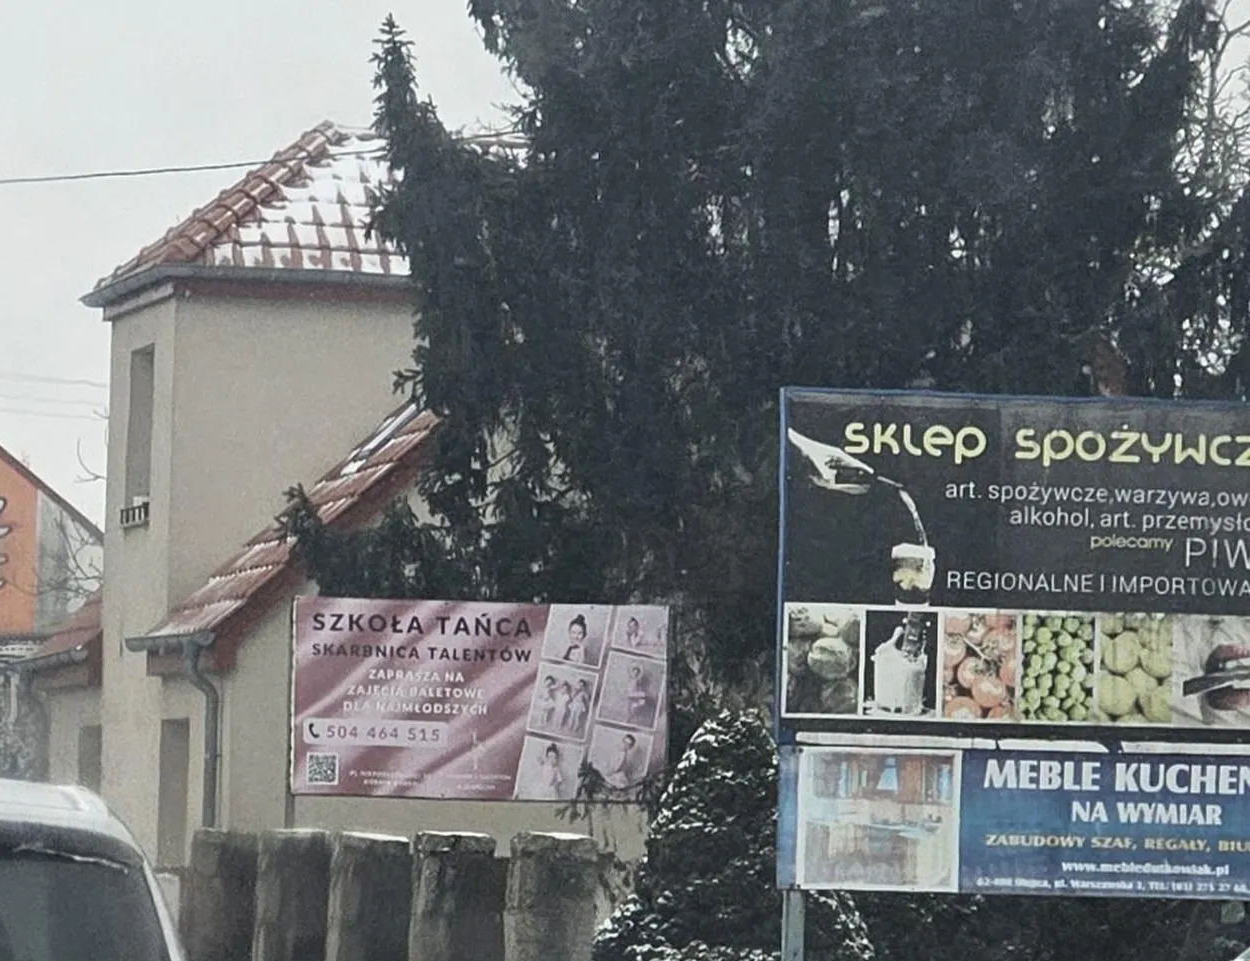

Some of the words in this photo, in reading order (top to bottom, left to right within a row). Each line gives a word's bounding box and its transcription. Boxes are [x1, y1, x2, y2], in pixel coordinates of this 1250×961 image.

[945, 482, 982, 499] art.
[1009, 506, 1095, 529] alkohol,
[1100, 511, 1136, 529] art.
[1090, 534, 1173, 549] polecamy
[1185, 537, 1250, 571] PIW
[947, 570, 1093, 593] REGIONALNE
[1112, 576, 1250, 597] IMPORTOWA
[312, 613, 424, 635] SZKOŁA
[436, 612, 532, 637] TAŃCA
[312, 643, 420, 660] SKARBNICA
[428, 645, 532, 663] TALENTÓW
[368, 669, 441, 682] ZAPRASZA
[445, 672, 465, 682] NA
[343, 701, 371, 712] DLA
[376, 701, 488, 715] NAJMŁODSZYCH
[326, 725, 358, 738] 504
[366, 727, 398, 739] 464
[407, 729, 440, 742] 515
[983, 759, 1100, 791] MEBLE
[1071, 801, 1108, 822] NA
[1117, 802, 1222, 825] WYMIAR
[986, 834, 1085, 848] ZABUDOWY
[1091, 836, 1137, 850] SZAF,
[1144, 838, 1210, 853] REGAŁY,
